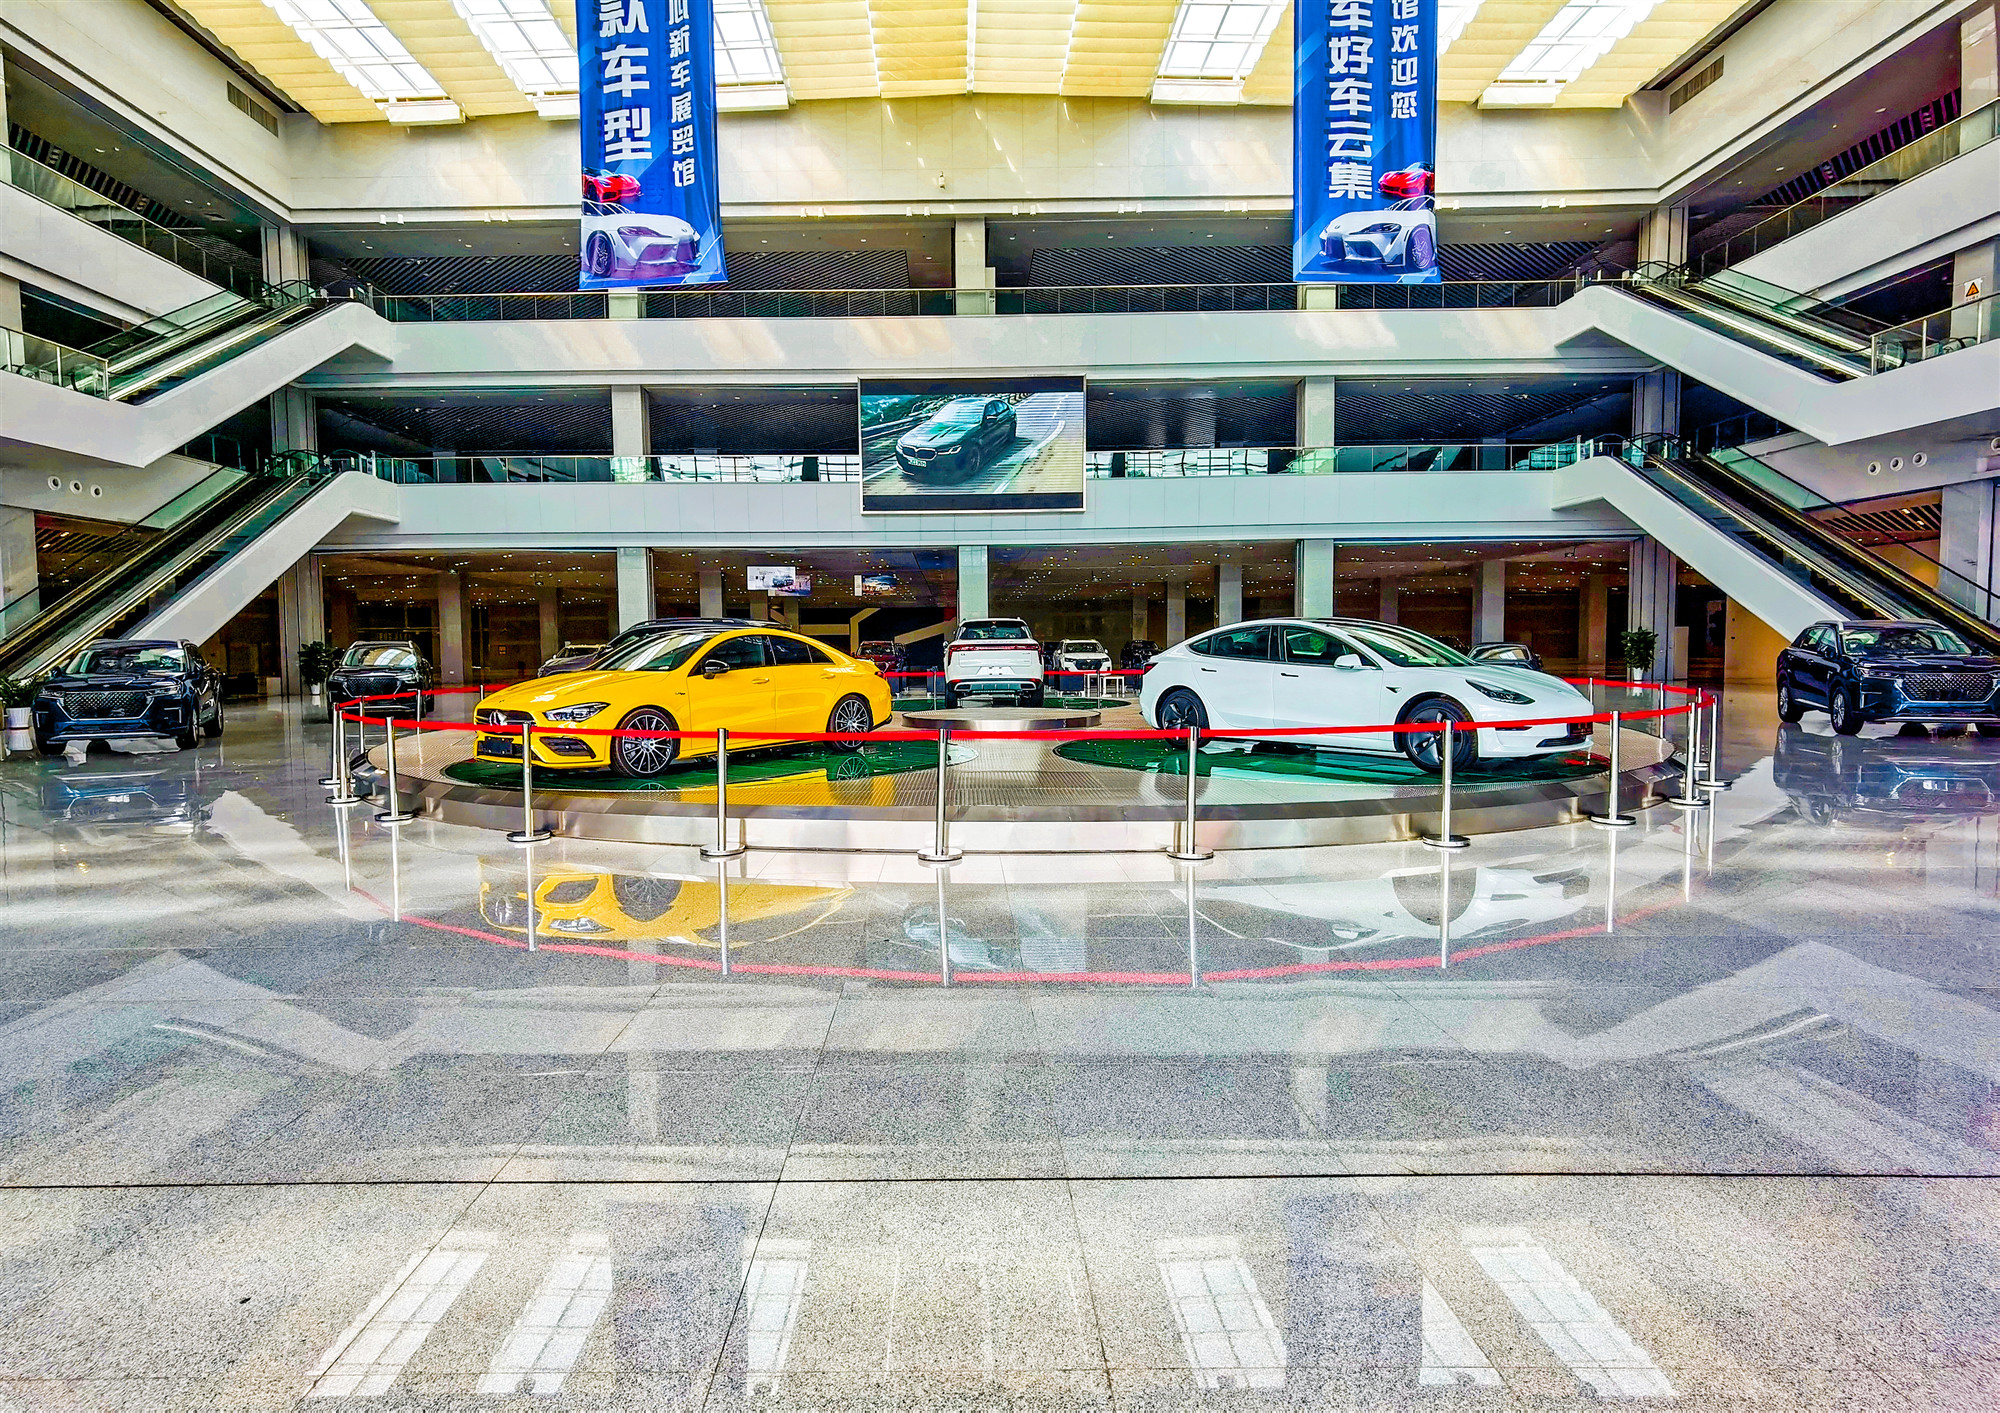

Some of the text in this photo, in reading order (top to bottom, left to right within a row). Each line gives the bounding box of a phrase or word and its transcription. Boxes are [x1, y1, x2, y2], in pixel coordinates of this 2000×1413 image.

[598, 0, 653, 163] 款车型
[1328, 0, 1374, 200] 车好车云集
